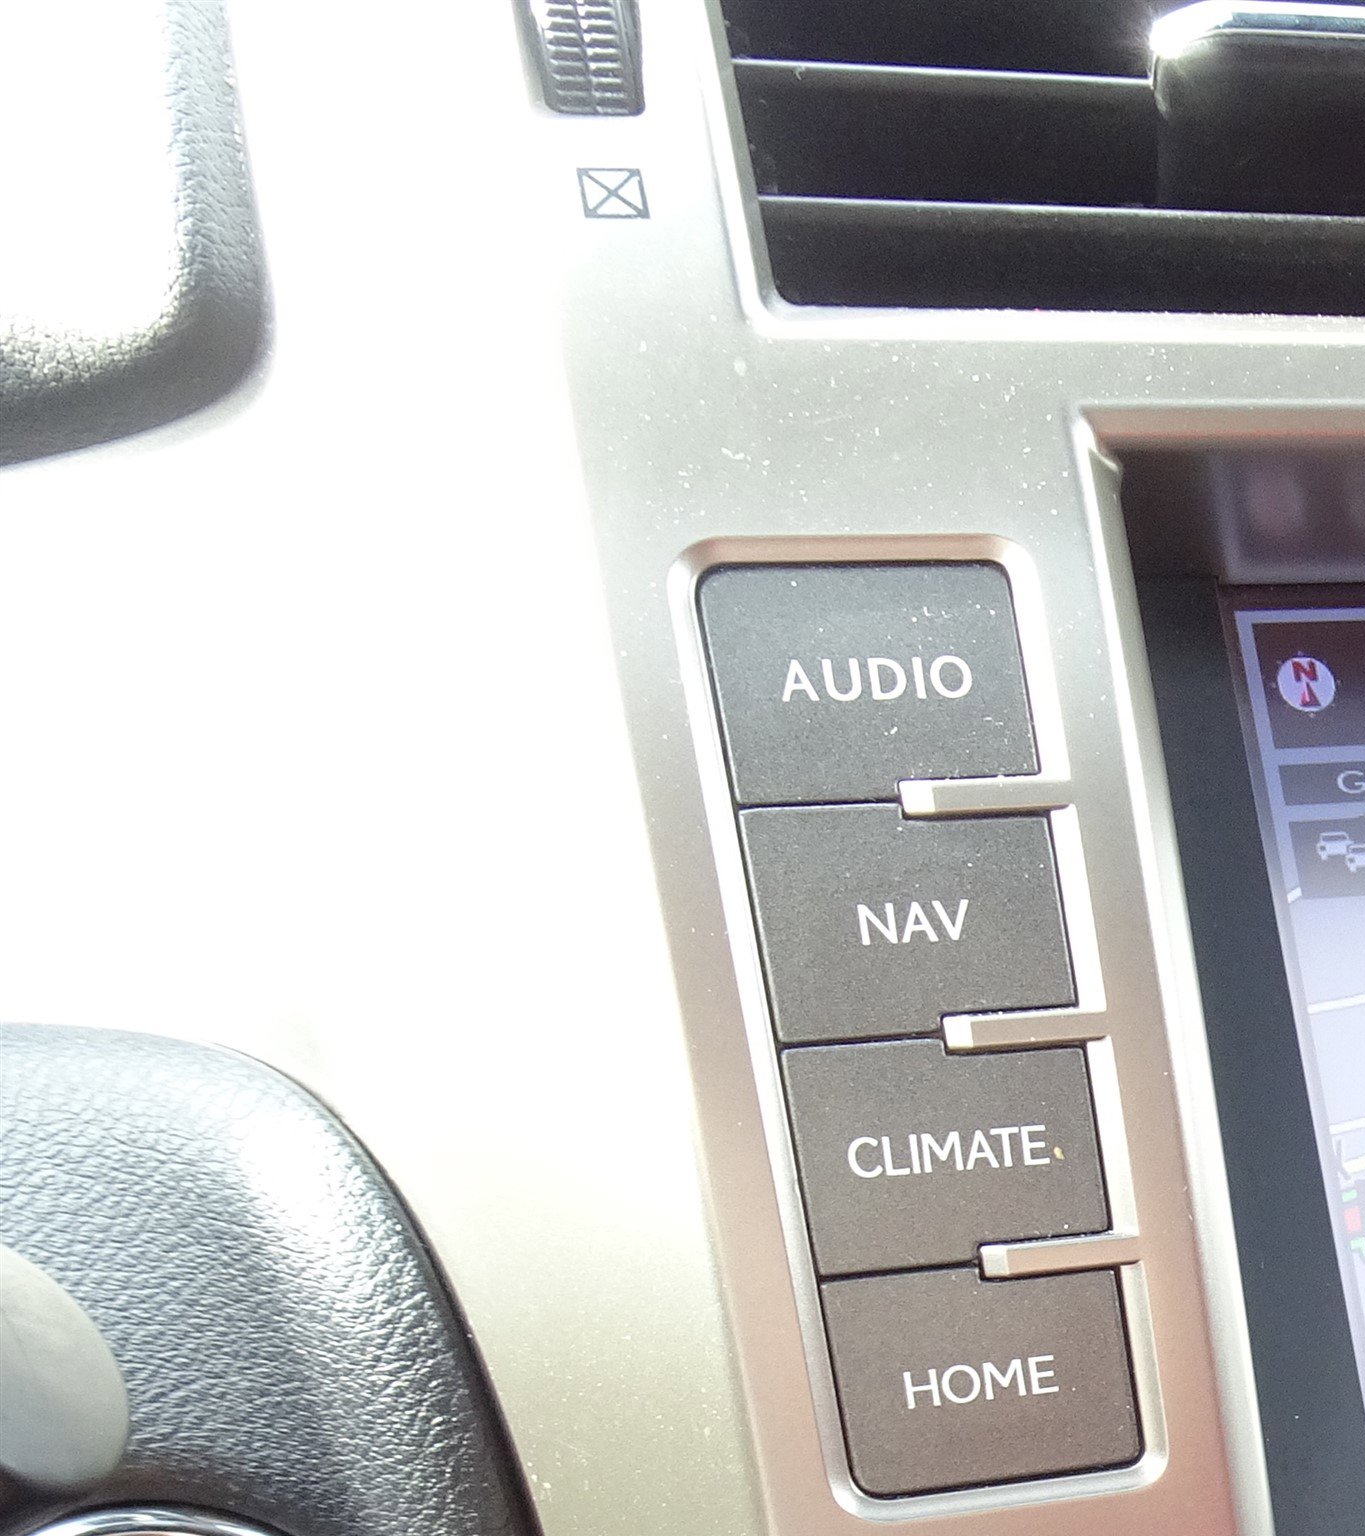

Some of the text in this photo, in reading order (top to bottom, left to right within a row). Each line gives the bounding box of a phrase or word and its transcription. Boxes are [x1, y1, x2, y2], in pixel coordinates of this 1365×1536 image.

[781, 655, 973, 702] AUDIO
[857, 899, 969, 945] NAV
[847, 1124, 1051, 1178] CLIMATE
[902, 1355, 1060, 1409] HOME
